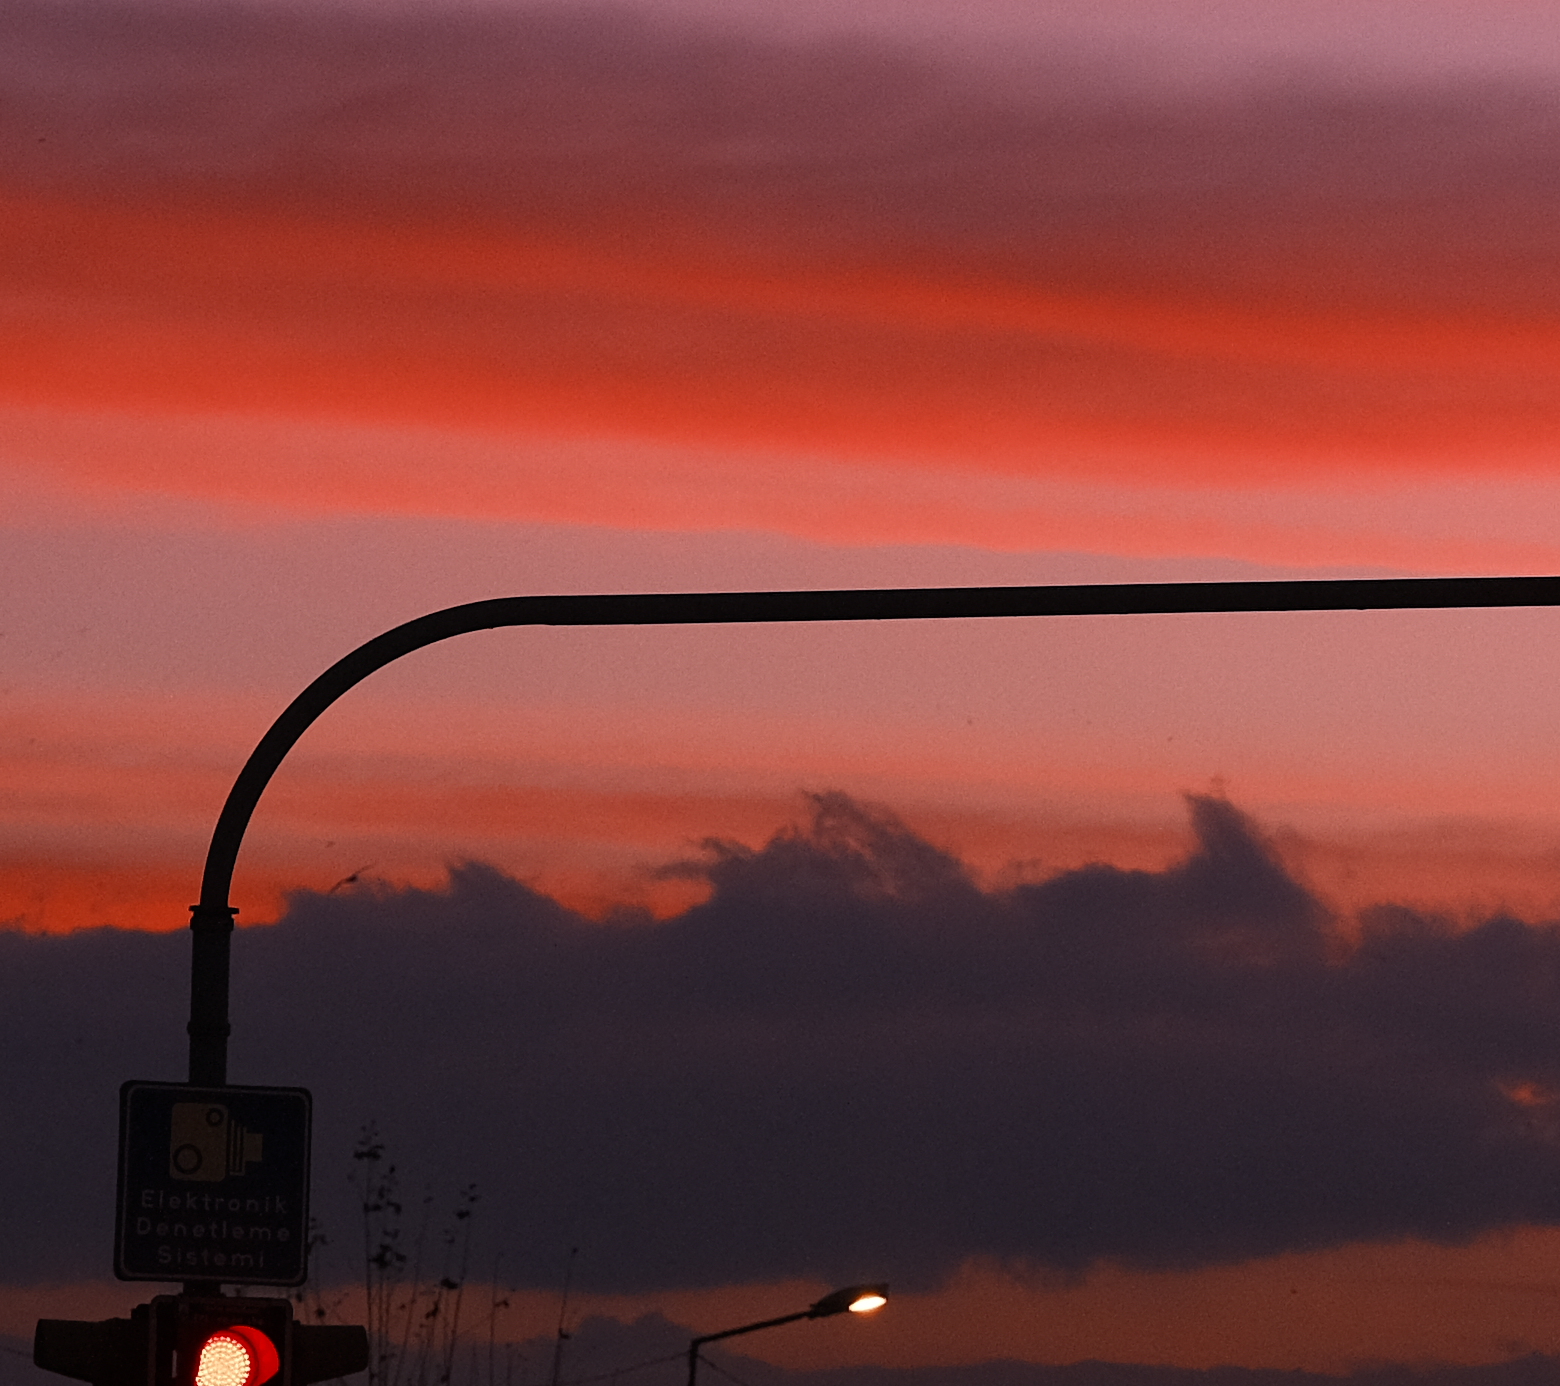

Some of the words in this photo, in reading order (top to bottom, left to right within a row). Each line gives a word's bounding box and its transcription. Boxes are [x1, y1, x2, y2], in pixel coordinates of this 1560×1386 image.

[141, 1189, 287, 1214] Elektronik
[136, 1216, 290, 1242] Denetleme
[157, 1244, 264, 1268] Sistemi
